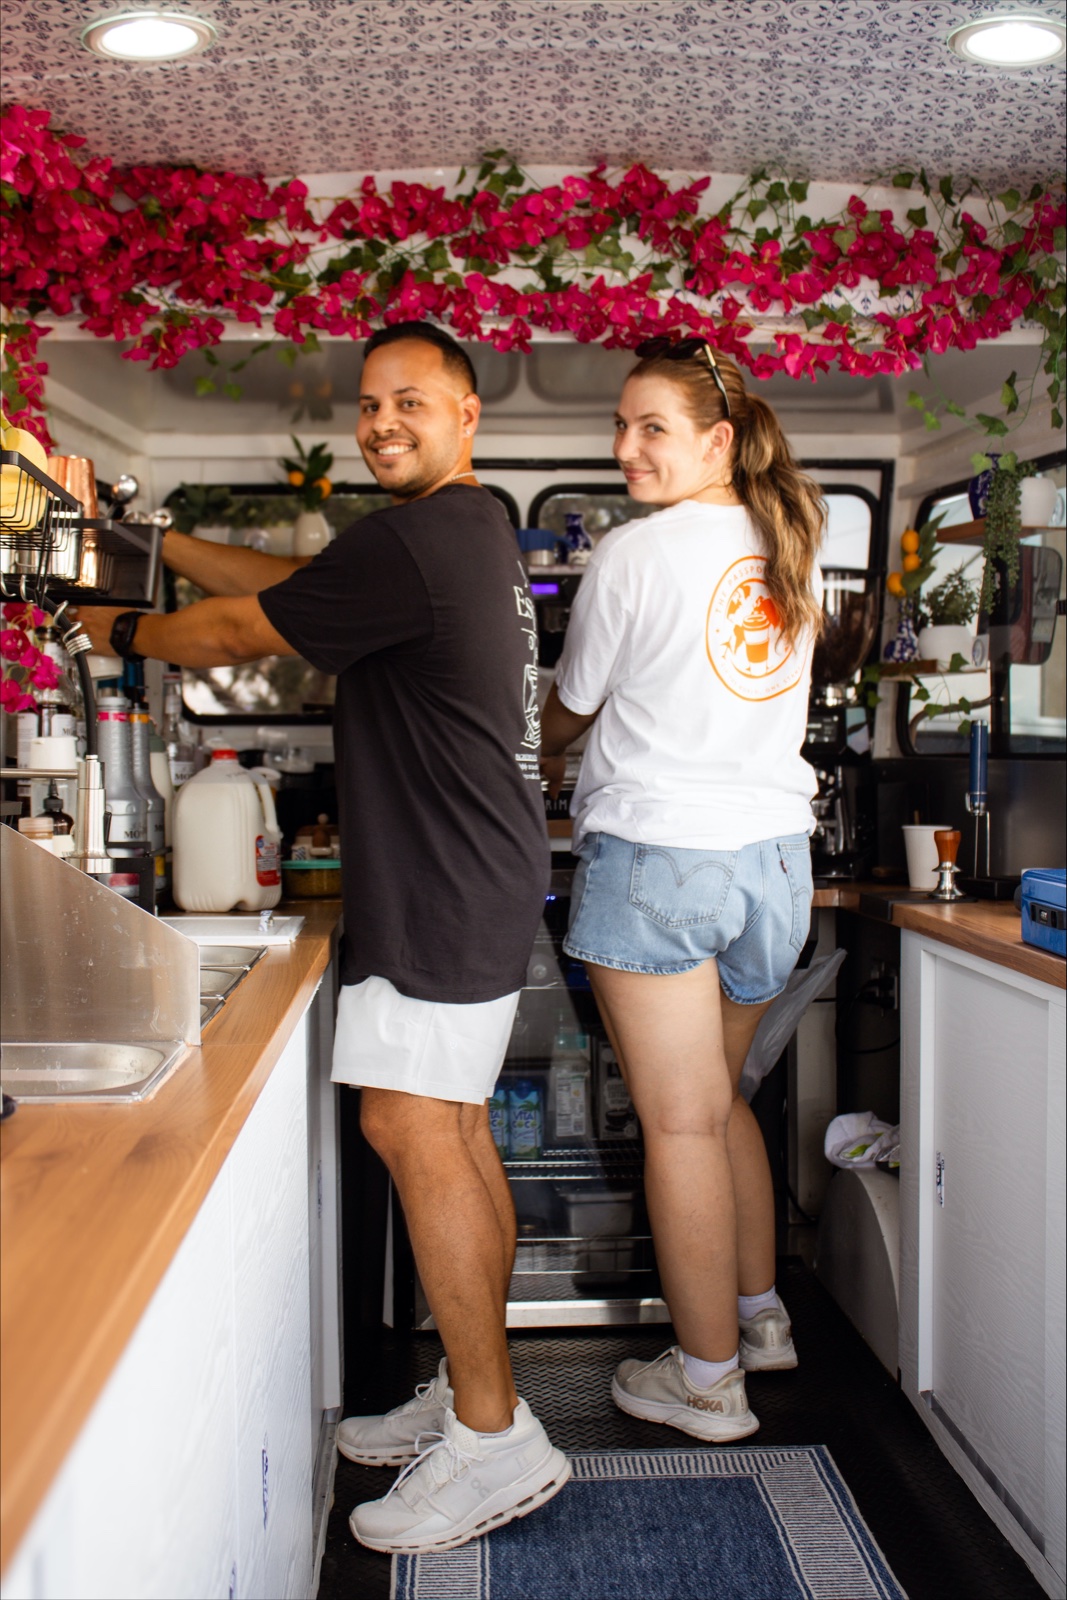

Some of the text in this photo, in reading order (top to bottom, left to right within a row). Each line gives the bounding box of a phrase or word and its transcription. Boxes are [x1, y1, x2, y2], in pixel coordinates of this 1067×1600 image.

[714, 565, 765, 613] THE PASSPO
[545, 799, 568, 811] RIM
[512, 1110, 534, 1120] VITA
[687, 1395, 724, 1413] HOKA
